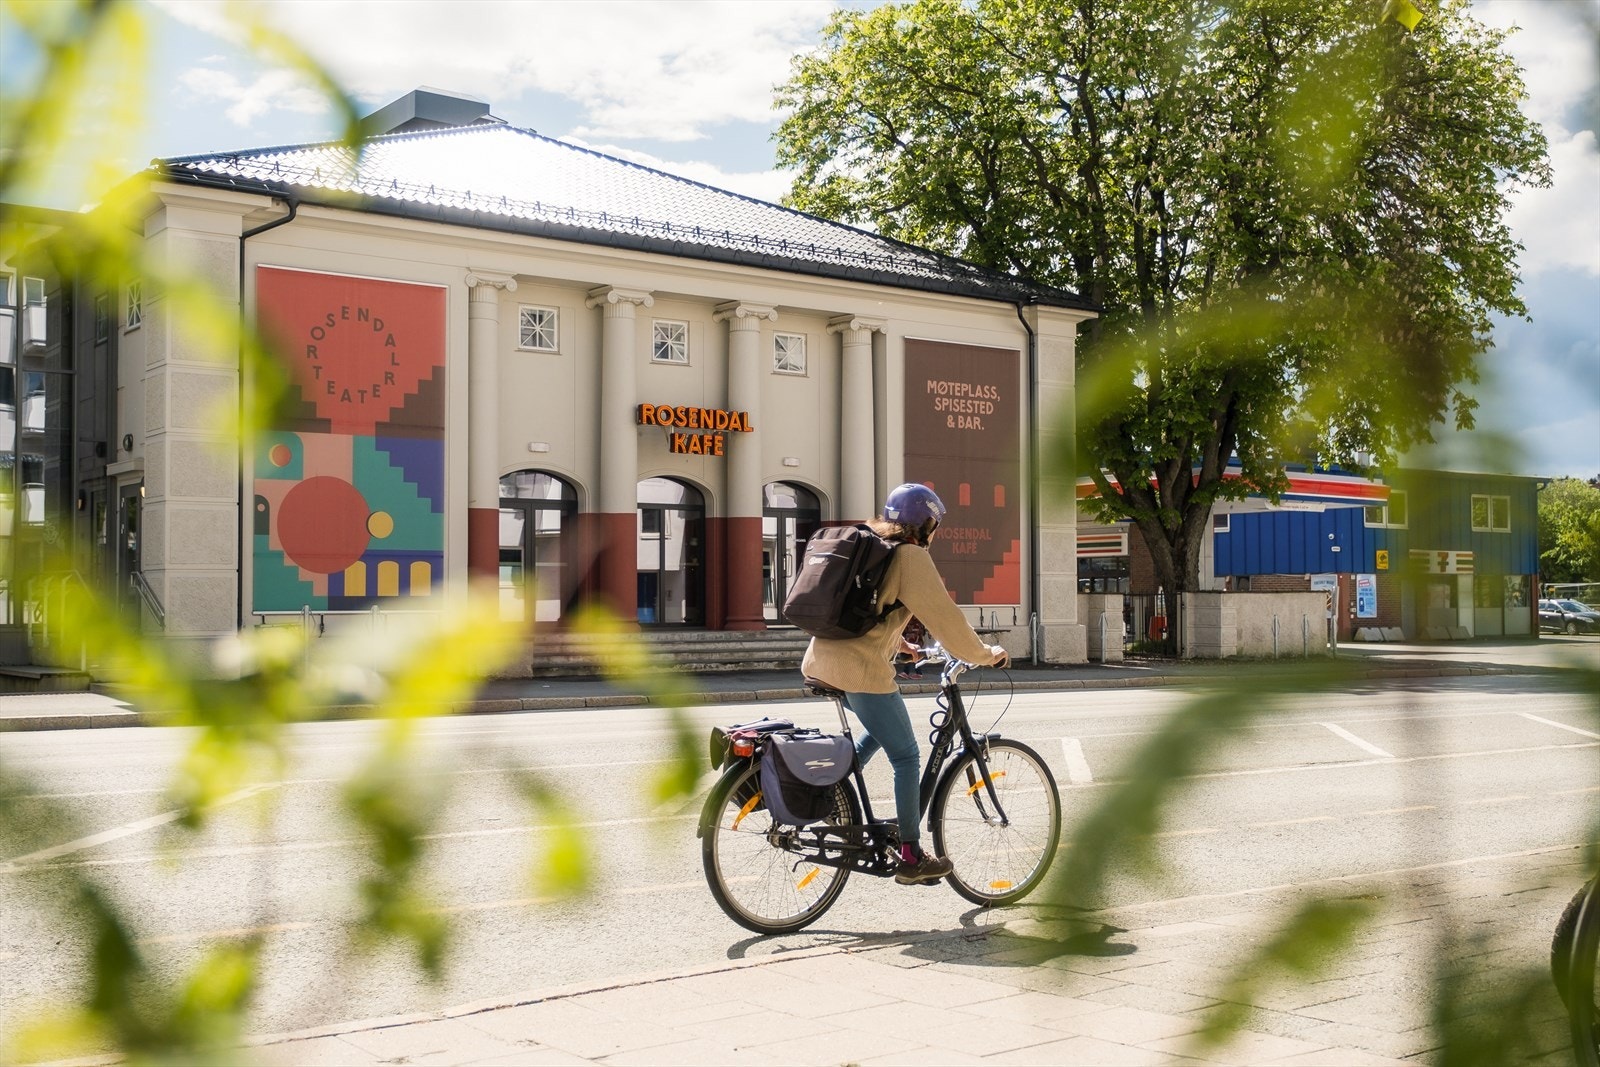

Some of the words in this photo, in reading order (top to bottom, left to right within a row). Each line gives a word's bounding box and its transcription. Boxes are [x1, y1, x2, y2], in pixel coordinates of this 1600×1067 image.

[306, 305, 400, 366] ROSENDAL
[313, 365, 395, 404] TEATER
[927, 380, 1000, 402] MØTEPLASS,
[934, 397, 994, 415] SPISESTED
[637, 403, 754, 432] ROSENDAL
[947, 414, 955, 428] &
[957, 415, 985, 430] BAR.
[670, 431, 724, 457] KAFÉ
[936, 527, 992, 540] ROSENDAL
[952, 540, 977, 554] KAFÉ
